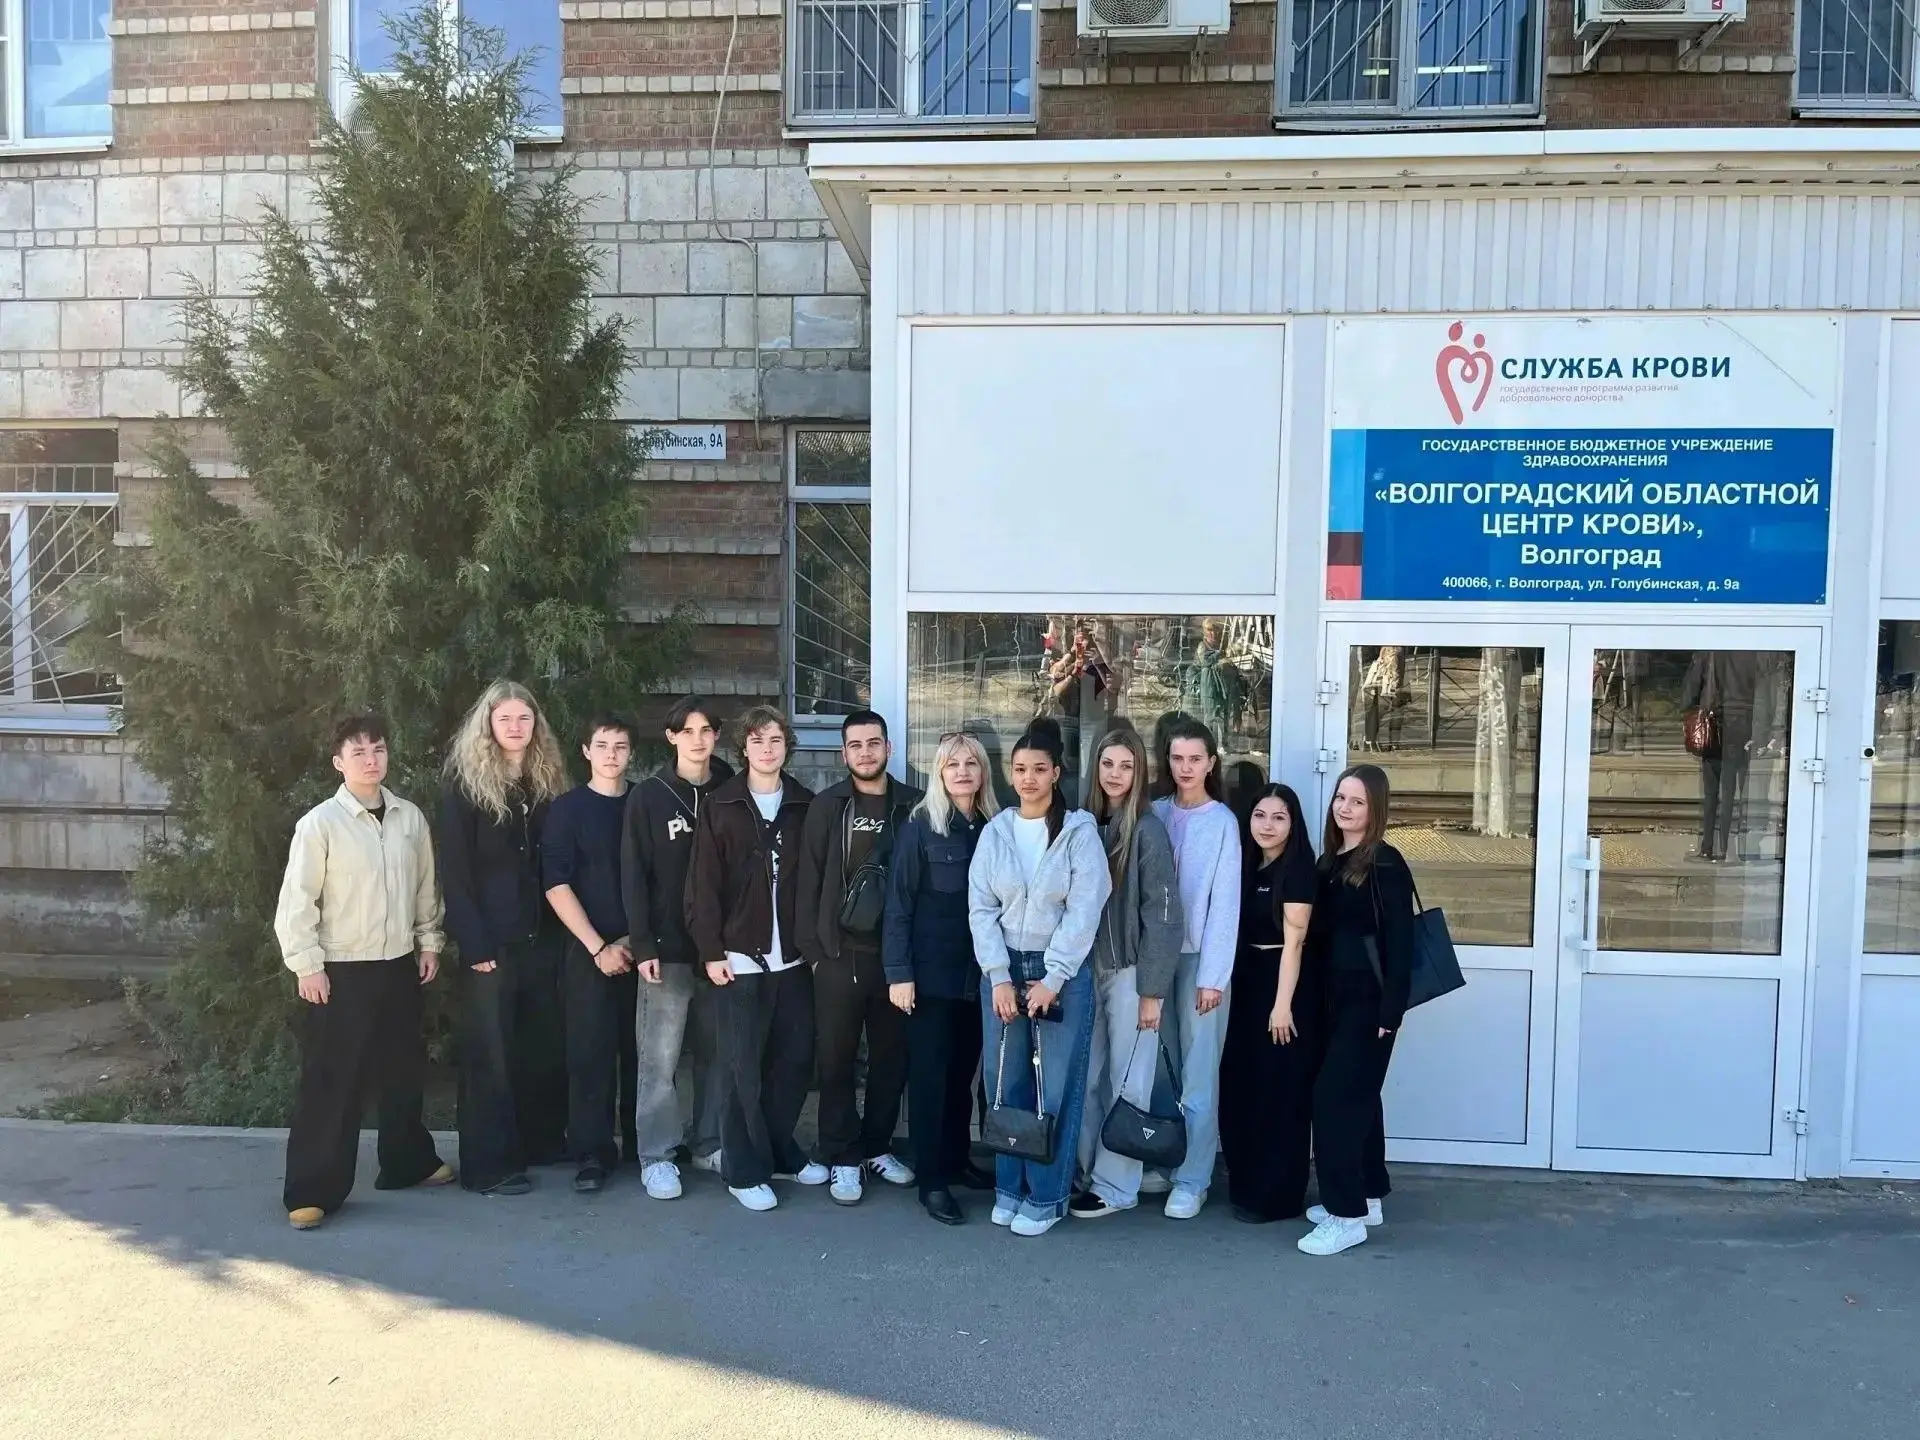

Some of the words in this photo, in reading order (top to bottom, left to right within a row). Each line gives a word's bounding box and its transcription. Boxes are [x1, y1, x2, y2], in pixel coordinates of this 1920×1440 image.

[1501, 357, 1623, 379] СЛУЖБА
[1632, 357, 1731, 378] КРОВИ
[1581, 384, 1633, 394] программа
[1635, 384, 1679, 393] развития
[647, 434, 707, 450] олубинская,
[1422, 439, 1566, 452] ГОСУДАРСТВЕННОЕ
[1570, 439, 1666, 452] БЮДЖЕТНОЕ
[1671, 439, 1774, 452] УЧРЕЖДЕНИЕ
[1522, 454, 1668, 468] ЗДРАВООХРАНЕНИЯ
[1375, 477, 1634, 507] «ВОЛГОГРАДСКИЙ
[1641, 478, 1820, 505] ОБЛАСТНОЙ
[1482, 513, 1574, 537] ЦЕНТР
[1582, 513, 1704, 539] КРОВИ»,
[1520, 543, 1662, 570] Волгоград
[1442, 577, 1492, 590] 400066,
[1495, 578, 1505, 588] г.
[1508, 577, 1584, 591] Волгоград,
[1587, 579, 1607, 591] ул.
[1610, 577, 1703, 592] Голубинская,
[1706, 581, 1720, 592] д.
[1723, 579, 1740, 590] 9а
